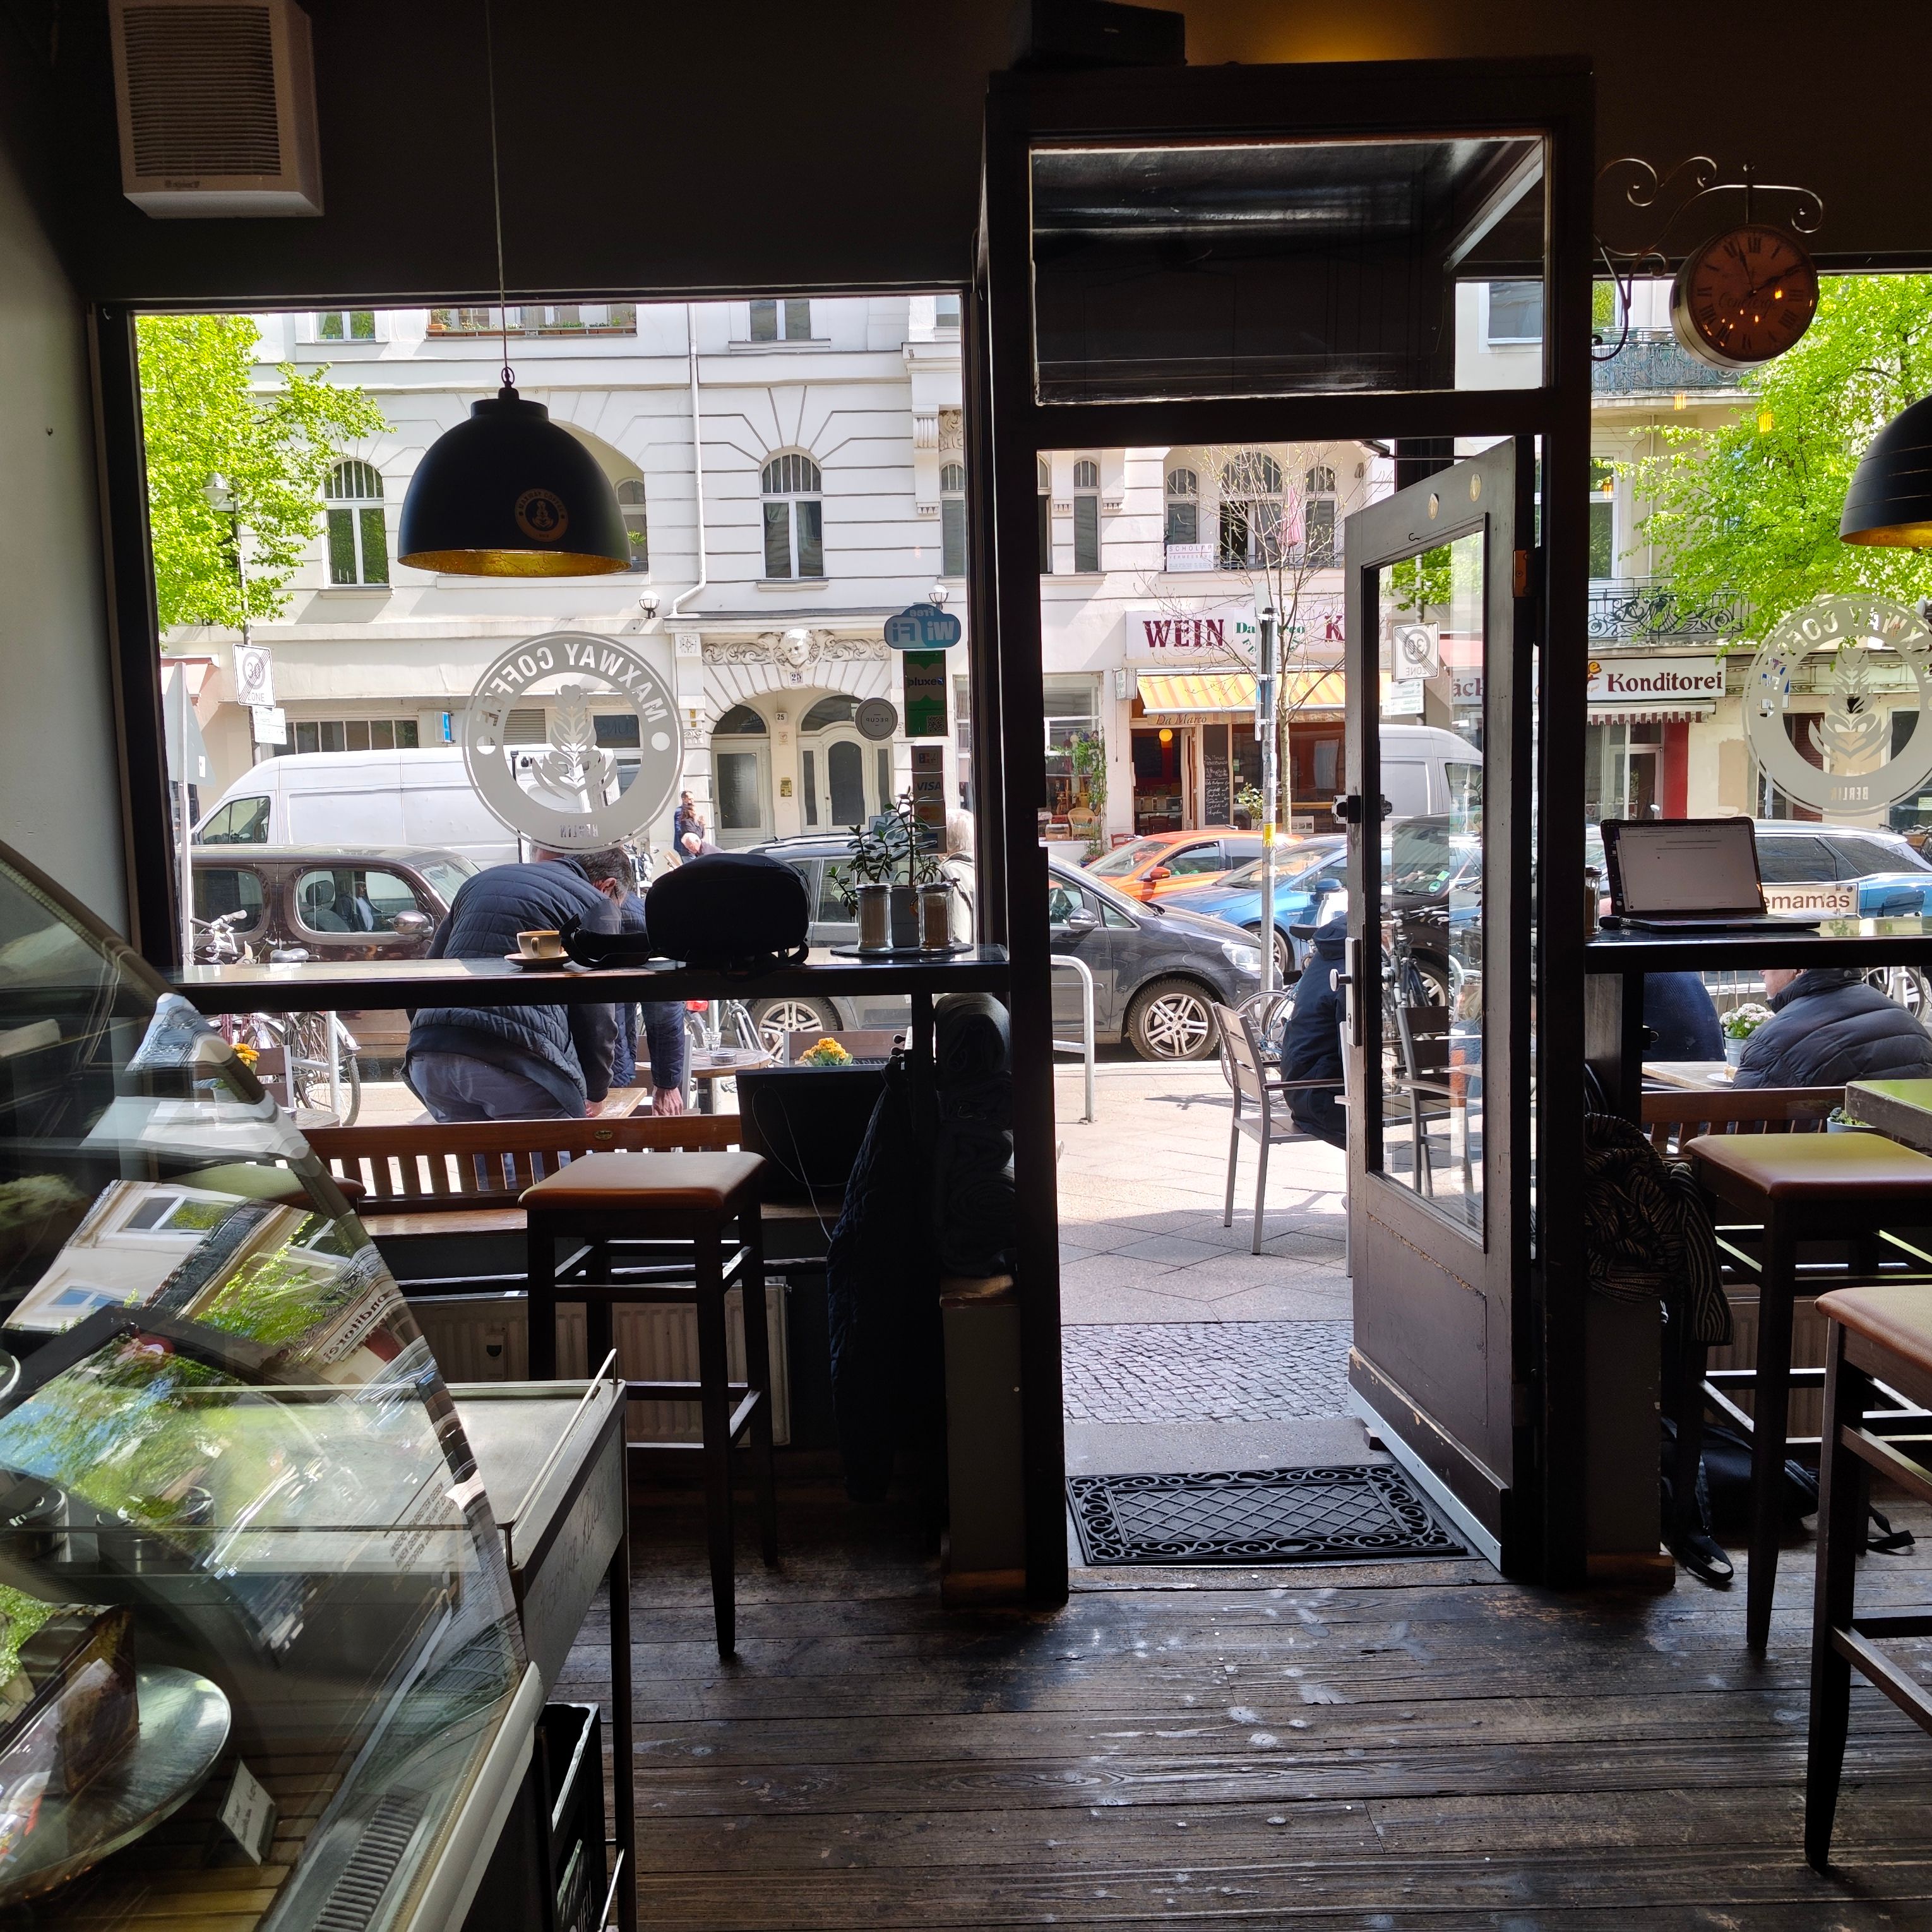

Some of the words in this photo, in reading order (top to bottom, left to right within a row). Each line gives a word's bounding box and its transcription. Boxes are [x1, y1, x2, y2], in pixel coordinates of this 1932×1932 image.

[1142, 619, 1224, 648] WEIN
[1236, 622, 1255, 633] Da
[1606, 671, 1724, 693] Konditorei
[1156, 715, 1171, 725] Da
[1174, 713, 1207, 725] Marco
[916, 781, 941, 791] VISA
